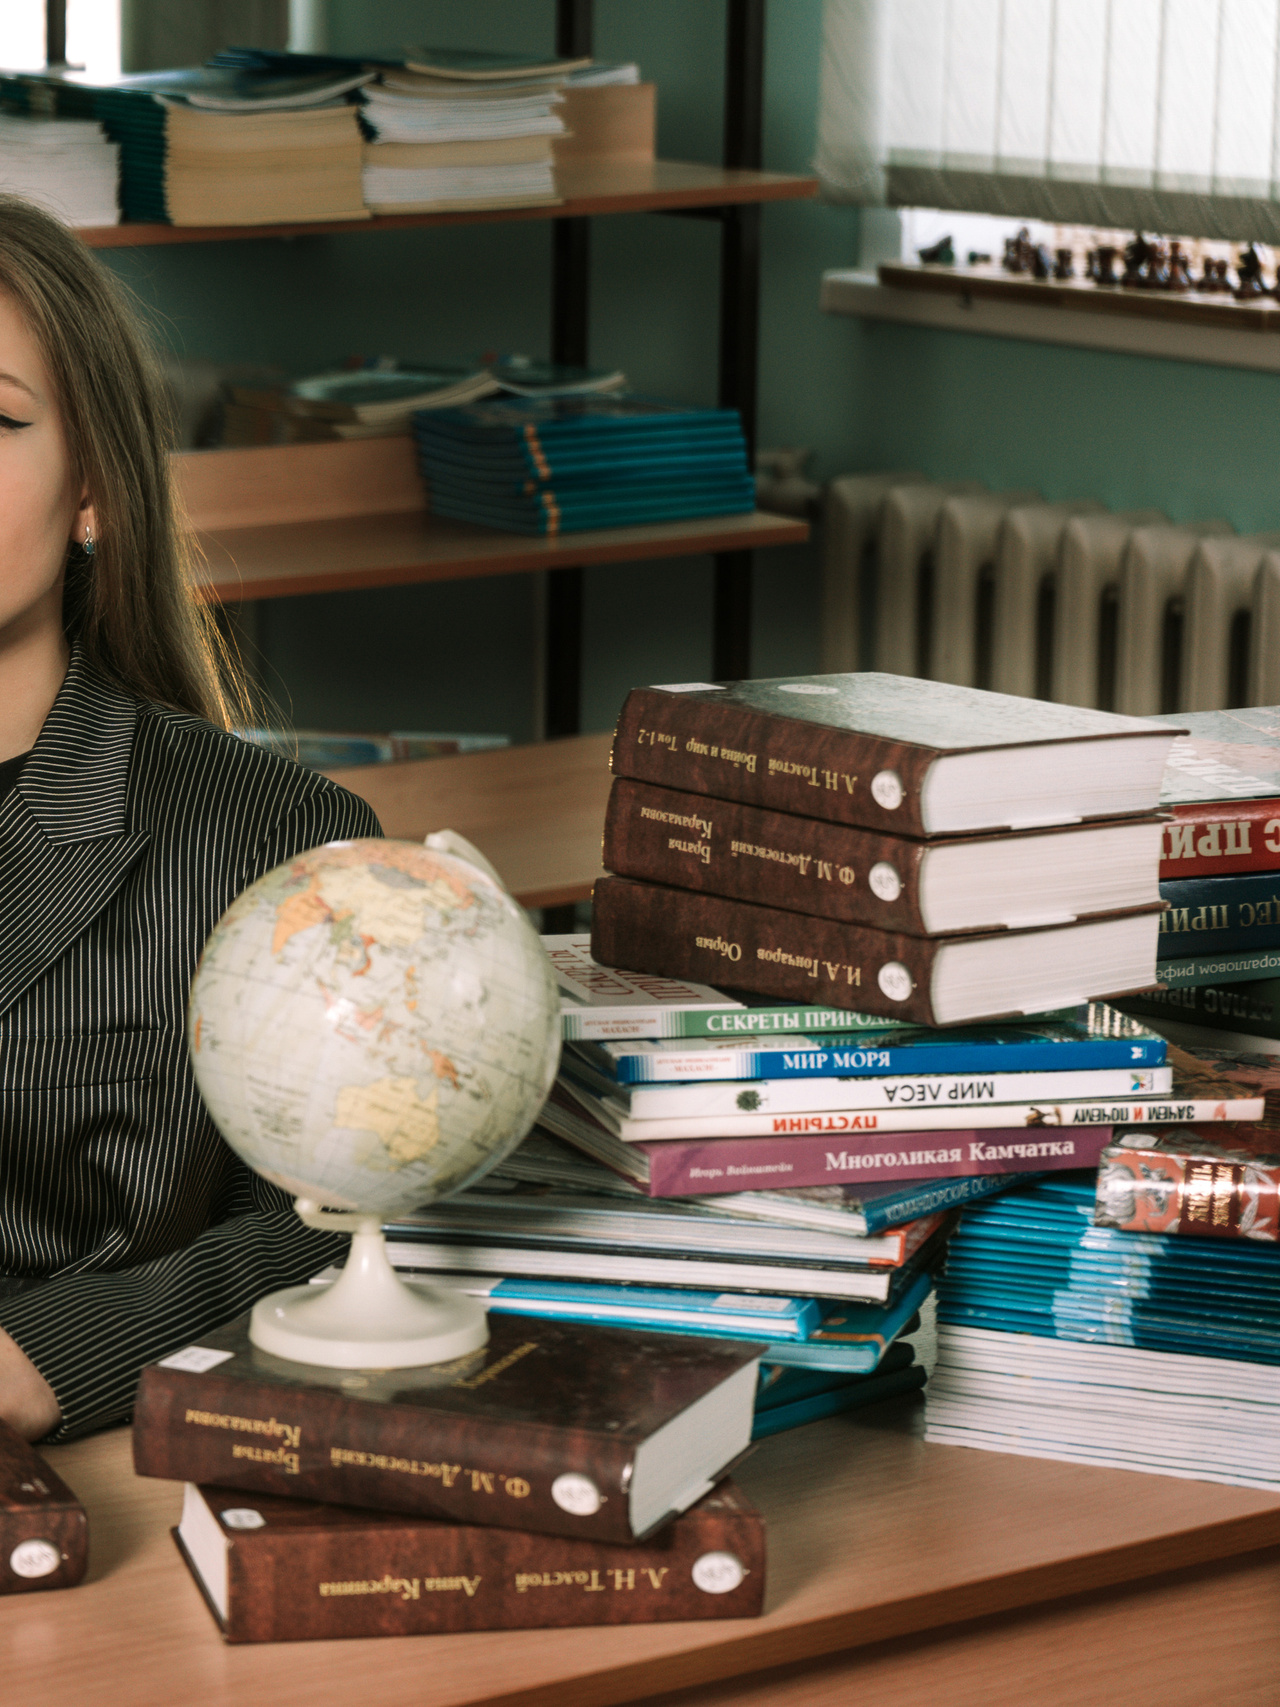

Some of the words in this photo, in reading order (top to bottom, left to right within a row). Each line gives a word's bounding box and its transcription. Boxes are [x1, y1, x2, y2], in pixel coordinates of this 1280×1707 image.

[656, 733, 678, 751] Том
[685, 737, 710, 757] мир
[710, 745, 719, 758] и
[720, 747, 758, 773] Война
[768, 758, 821, 787] Толстой
[640, 806, 714, 840] Карамазовы
[668, 837, 712, 864] Братья
[730, 839, 812, 876] Достоевский
[695, 935, 743, 962] Обрыв
[757, 947, 819, 979] Гончаров
[822, 959, 840, 983] А.
[844, 965, 863, 987] И.
[706, 1010, 800, 1032] СЕКРЕТЫ
[782, 1052, 829, 1071] МИР
[833, 1050, 891, 1069] МОРЯ
[883, 1083, 942, 1103] ЛЕСА
[948, 1080, 995, 1101] МИР
[772, 1115, 879, 1133] ПУСТЫНИ
[1072, 1106, 1129, 1123] ПОЧЕМУ
[1132, 1106, 1144, 1121] И
[1147, 1104, 1195, 1121] ЗАЧЕМ
[825, 1146, 963, 1172] Многоликая
[967, 1138, 1076, 1162] Камчатка
[184, 1408, 302, 1448] Карамазовы
[232, 1443, 300, 1475] Братья
[330, 1446, 462, 1488] Достоевский
[464, 1467, 495, 1495] М.
[498, 1473, 531, 1499] Ф.
[319, 1574, 421, 1600] Каренина
[424, 1574, 483, 1597] Анна
[514, 1569, 605, 1594] Толстой
[606, 1568, 636, 1591] Н.
